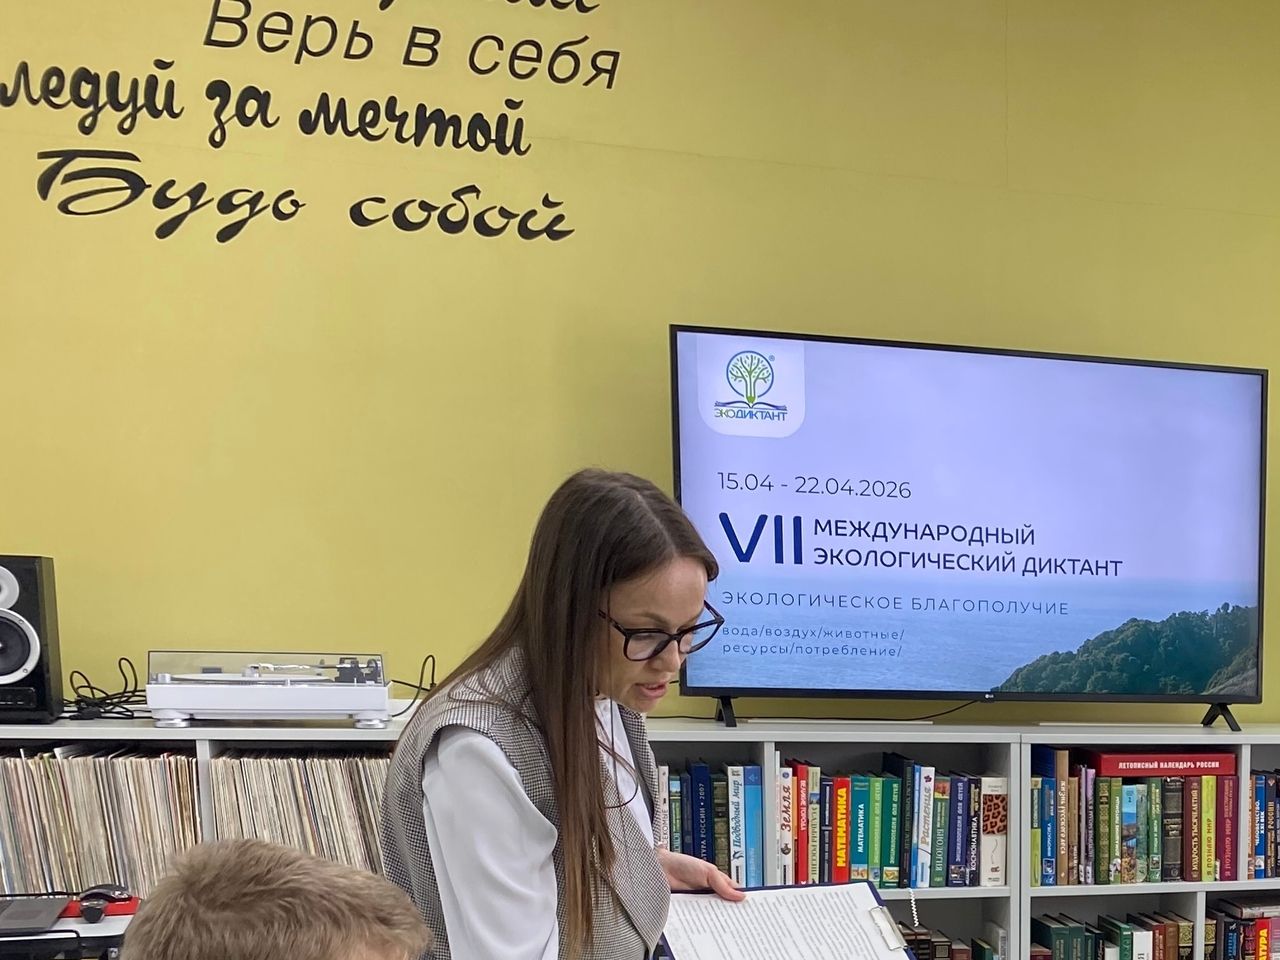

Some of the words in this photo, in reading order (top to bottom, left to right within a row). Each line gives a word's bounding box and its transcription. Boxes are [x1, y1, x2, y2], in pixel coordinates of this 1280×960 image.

[203, 0, 374, 64] Верь
[402, 26, 441, 67] в
[468, 35, 620, 89] себя
[0, 59, 184, 136] ледуй
[205, 79, 280, 149] за
[299, 92, 531, 156] мечтой
[36, 148, 306, 243] Будь
[349, 184, 575, 241] собой
[714, 408, 788, 421] ЭКОДИКТАНТ
[717, 472, 774, 491] 15.04
[795, 476, 911, 498] 22.04.2026
[719, 512, 803, 565] VII
[814, 518, 1035, 547] МЕЖДУНАРОДНЫЙ
[814, 547, 1015, 573] ЭКОЛОГИЧЕСКИЙ
[1022, 557, 1123, 577] ДИКТАНТ
[722, 591, 902, 609] ЭКОЛОГИЧЕСКОЕ
[911, 597, 1069, 615] БЛАГОПОЛУЧИЕ
[722, 625, 905, 640] вода/воздух/животные/
[722, 643, 902, 657] ресурсы/потребление/
[1118, 761, 1158, 769] ЛЕТОПИСНЫЙ
[1160, 761, 1194, 769] КАЛЕНДАРЬ
[732, 780, 742, 799] мир
[781, 785, 791, 832] Земля
[661, 809, 669, 850] АСЕКОМЫЕ
[731, 801, 741, 848] Подводный
[836, 788, 847, 867] МАТЕМАТИКА
[920, 786, 932, 845] Растения
[1191, 790, 1199, 836] ТЫСЯЧЕЛЕТИЙ
[936, 828, 944, 871] БИОЛОГИЯ
[970, 817, 978, 870] КОСМОНАВТИКА
[1191, 837, 1199, 870] МУДРОСТЬ
